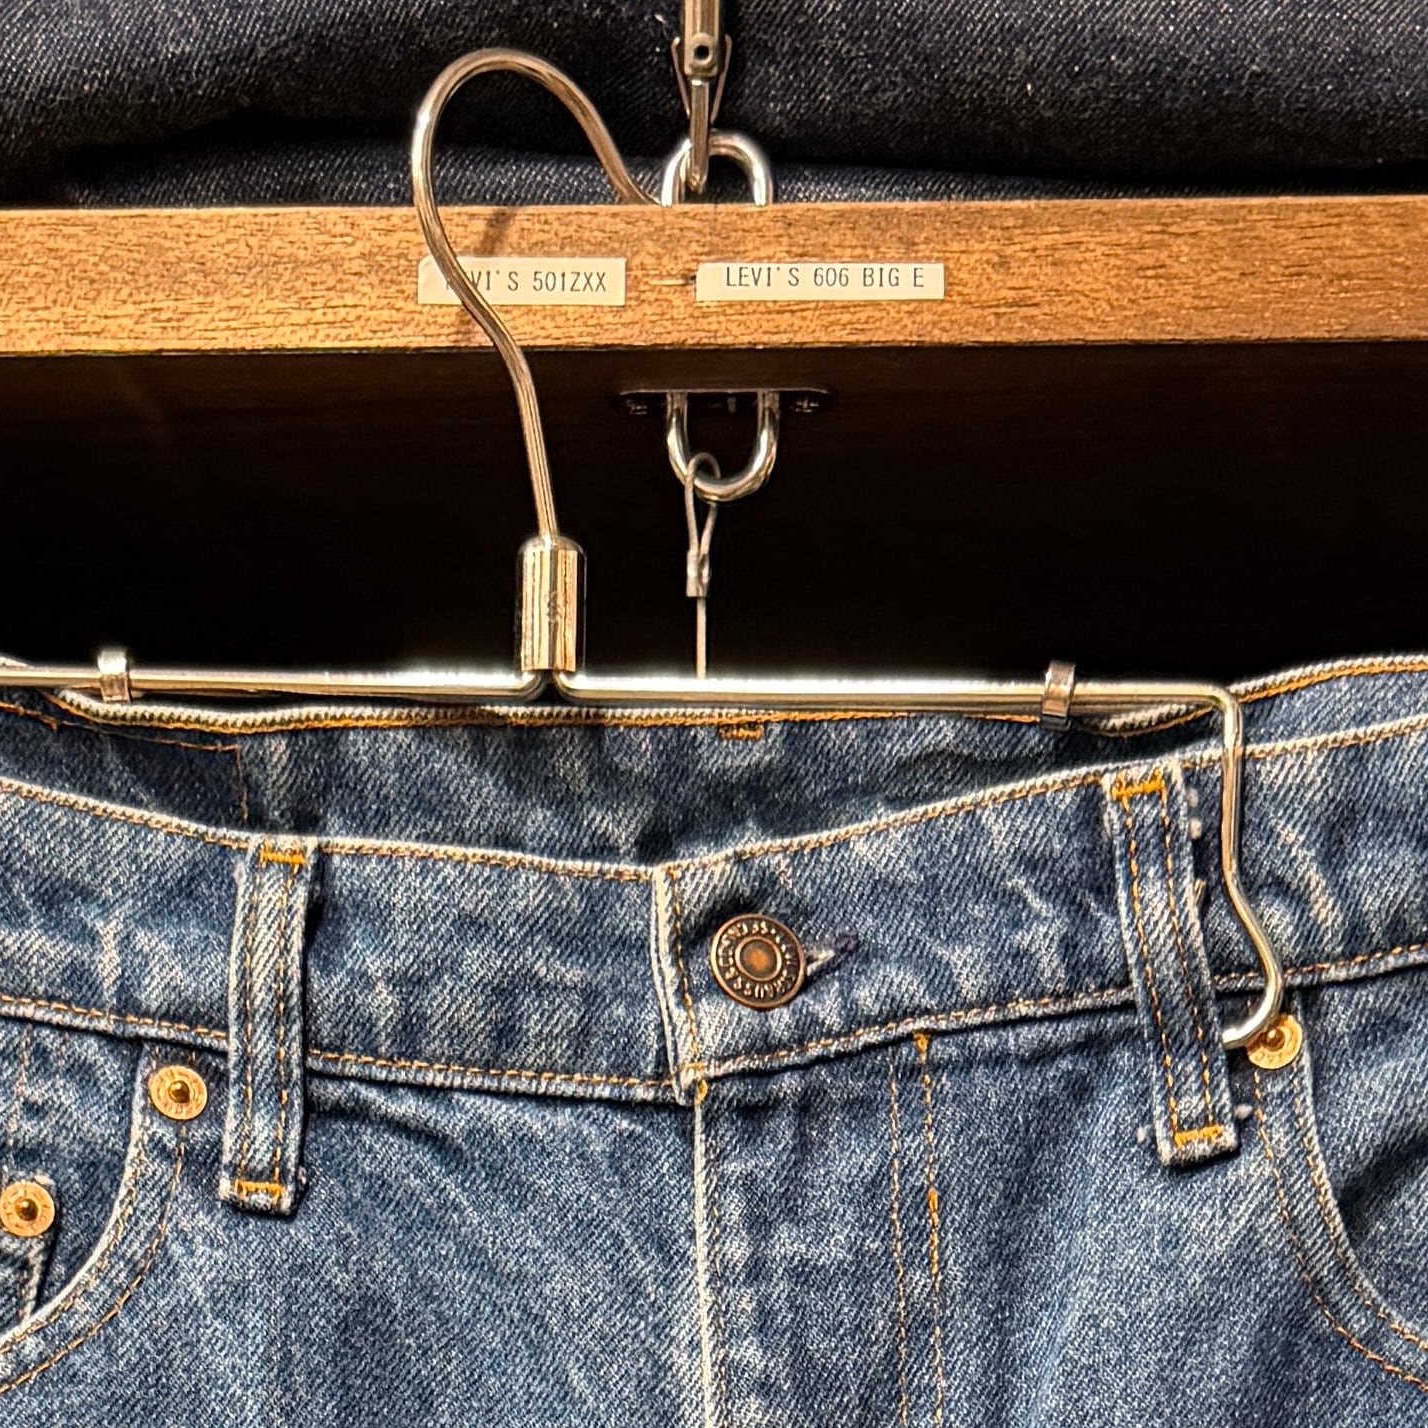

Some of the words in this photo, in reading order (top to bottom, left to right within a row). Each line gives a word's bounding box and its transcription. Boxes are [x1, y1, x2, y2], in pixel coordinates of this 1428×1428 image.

[445, 270, 519, 291] VI'S
[532, 271, 607, 292] 501ZXX
[725, 266, 800, 287] LEVI'S
[813, 267, 849, 287] 606
[863, 267, 900, 287] BIG
[913, 267, 925, 287] E
